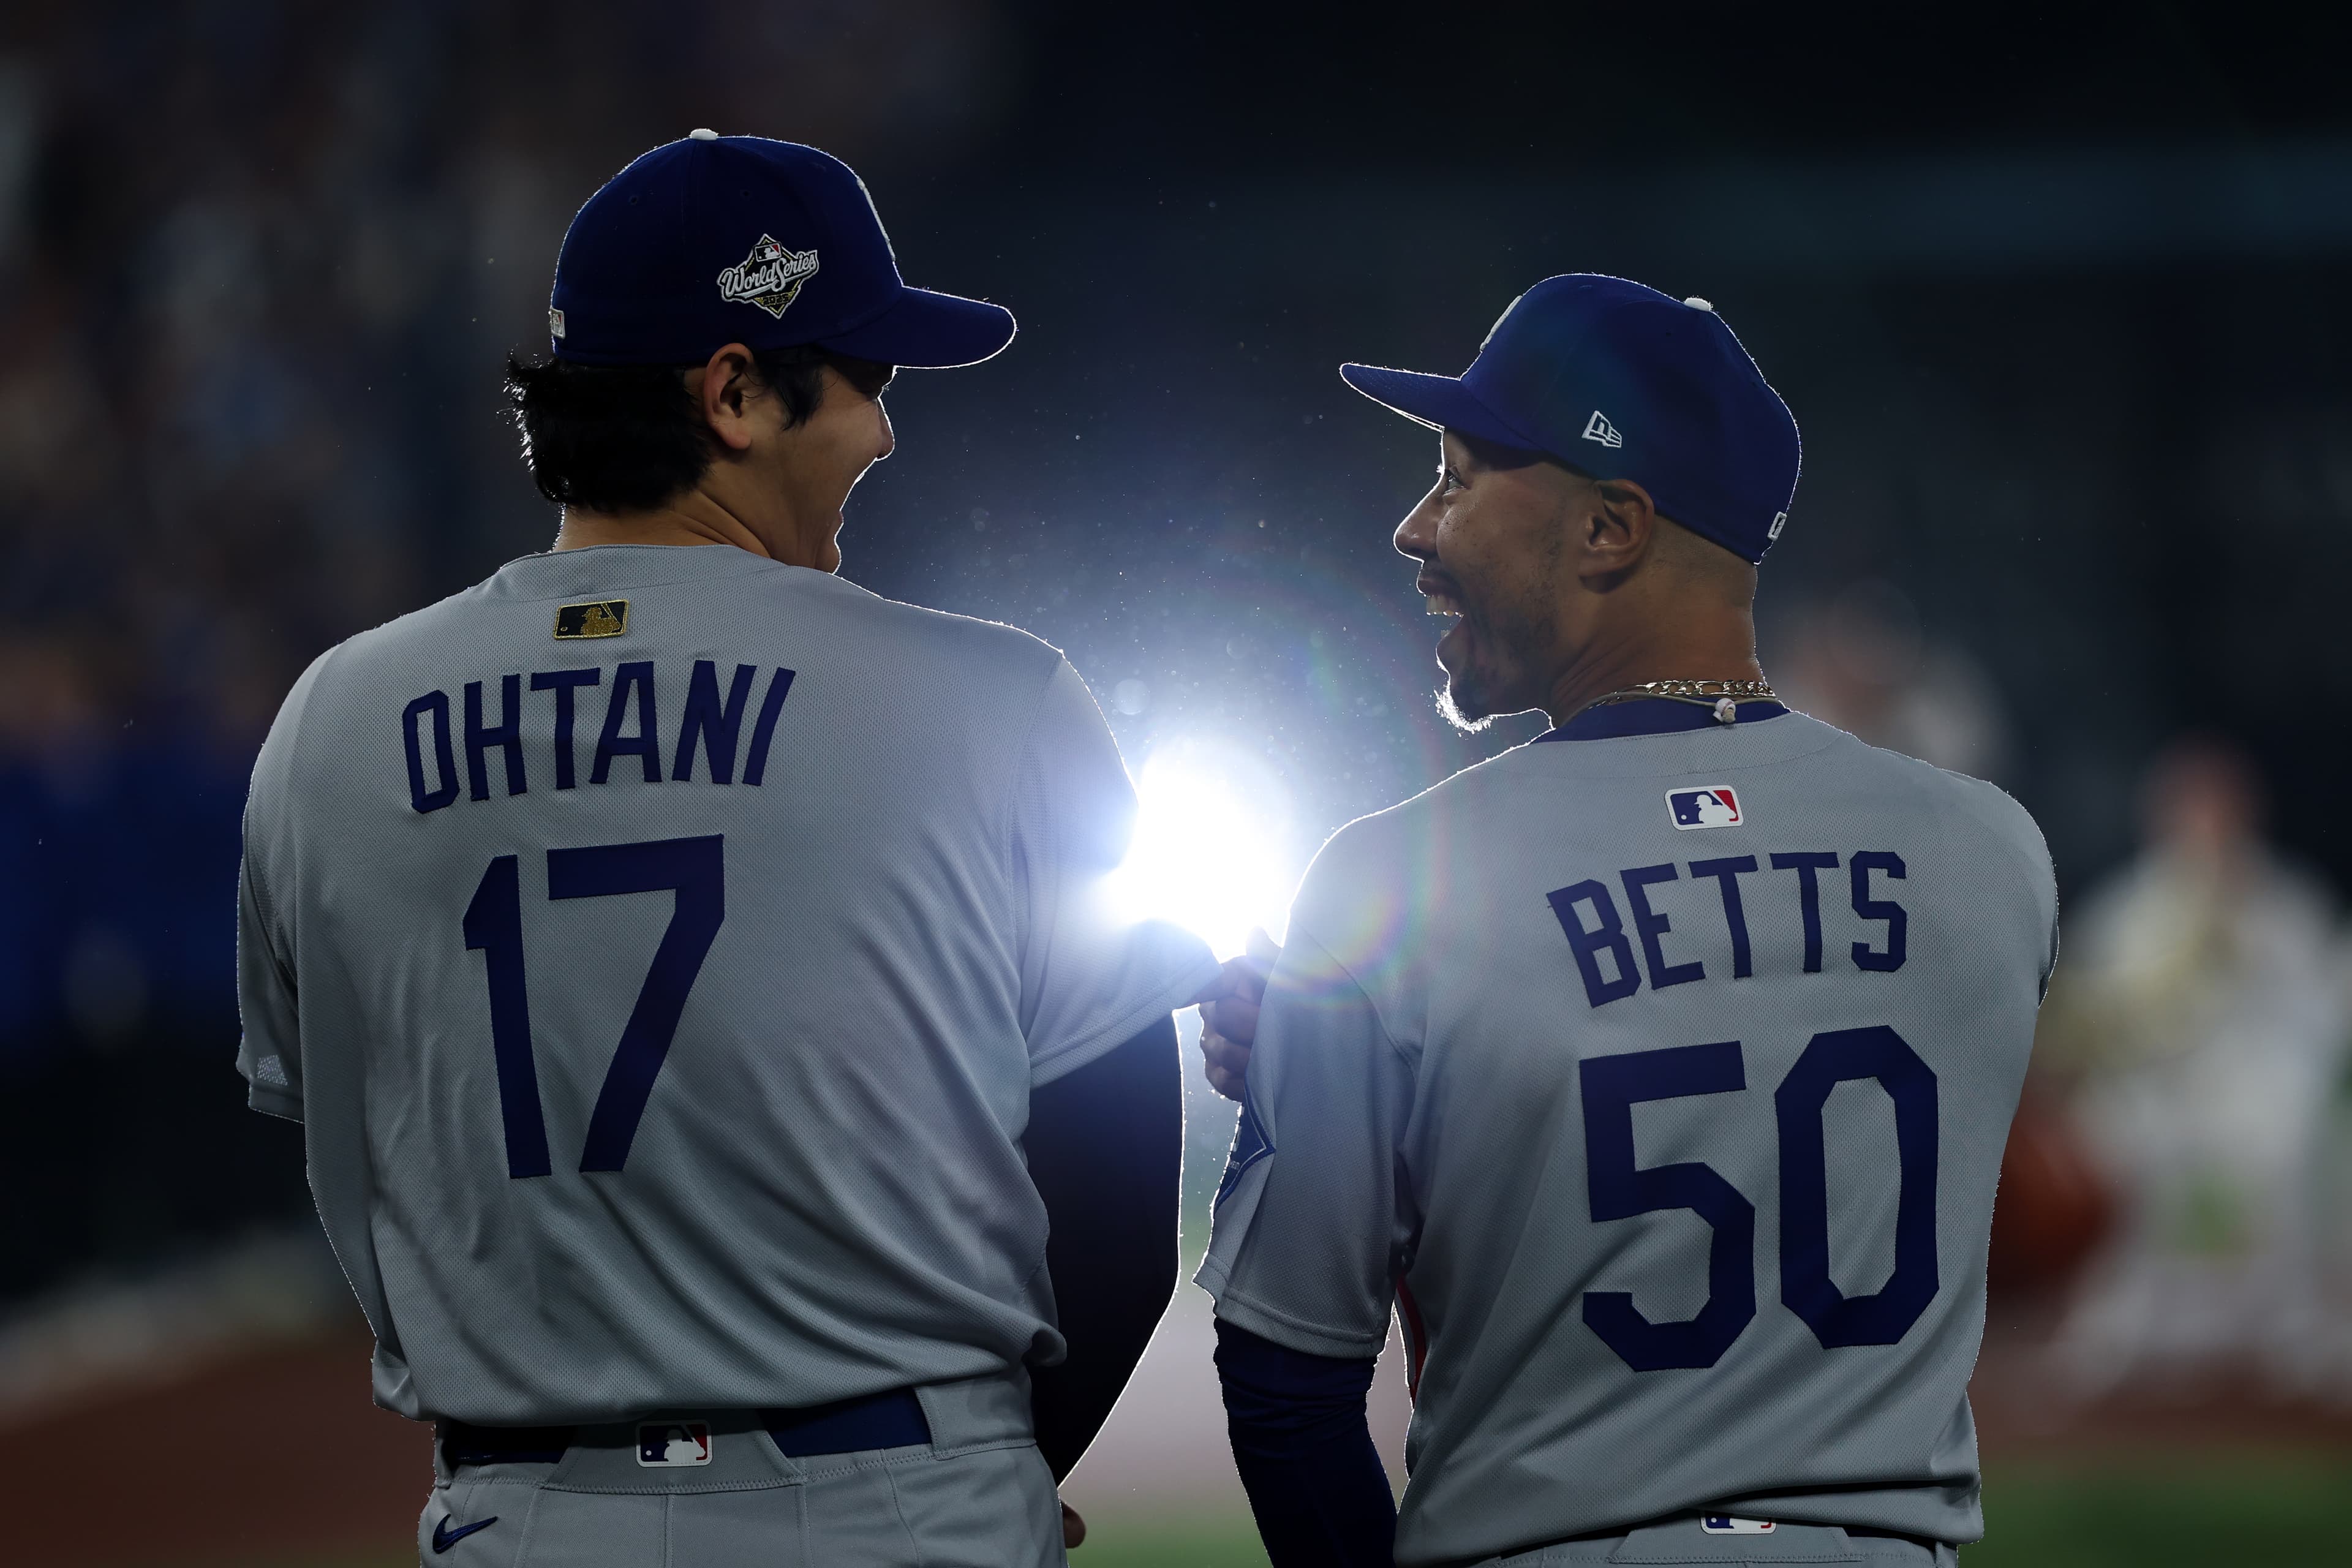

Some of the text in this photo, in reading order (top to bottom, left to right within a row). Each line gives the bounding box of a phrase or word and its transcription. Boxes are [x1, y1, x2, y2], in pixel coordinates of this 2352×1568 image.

[721, 253, 817, 298] World Series
[402, 660, 796, 814] OHTANI
[462, 834, 725, 1179] 17
[1547, 851, 1907, 1009] BETTS
[1580, 1025, 1940, 1372] 50
